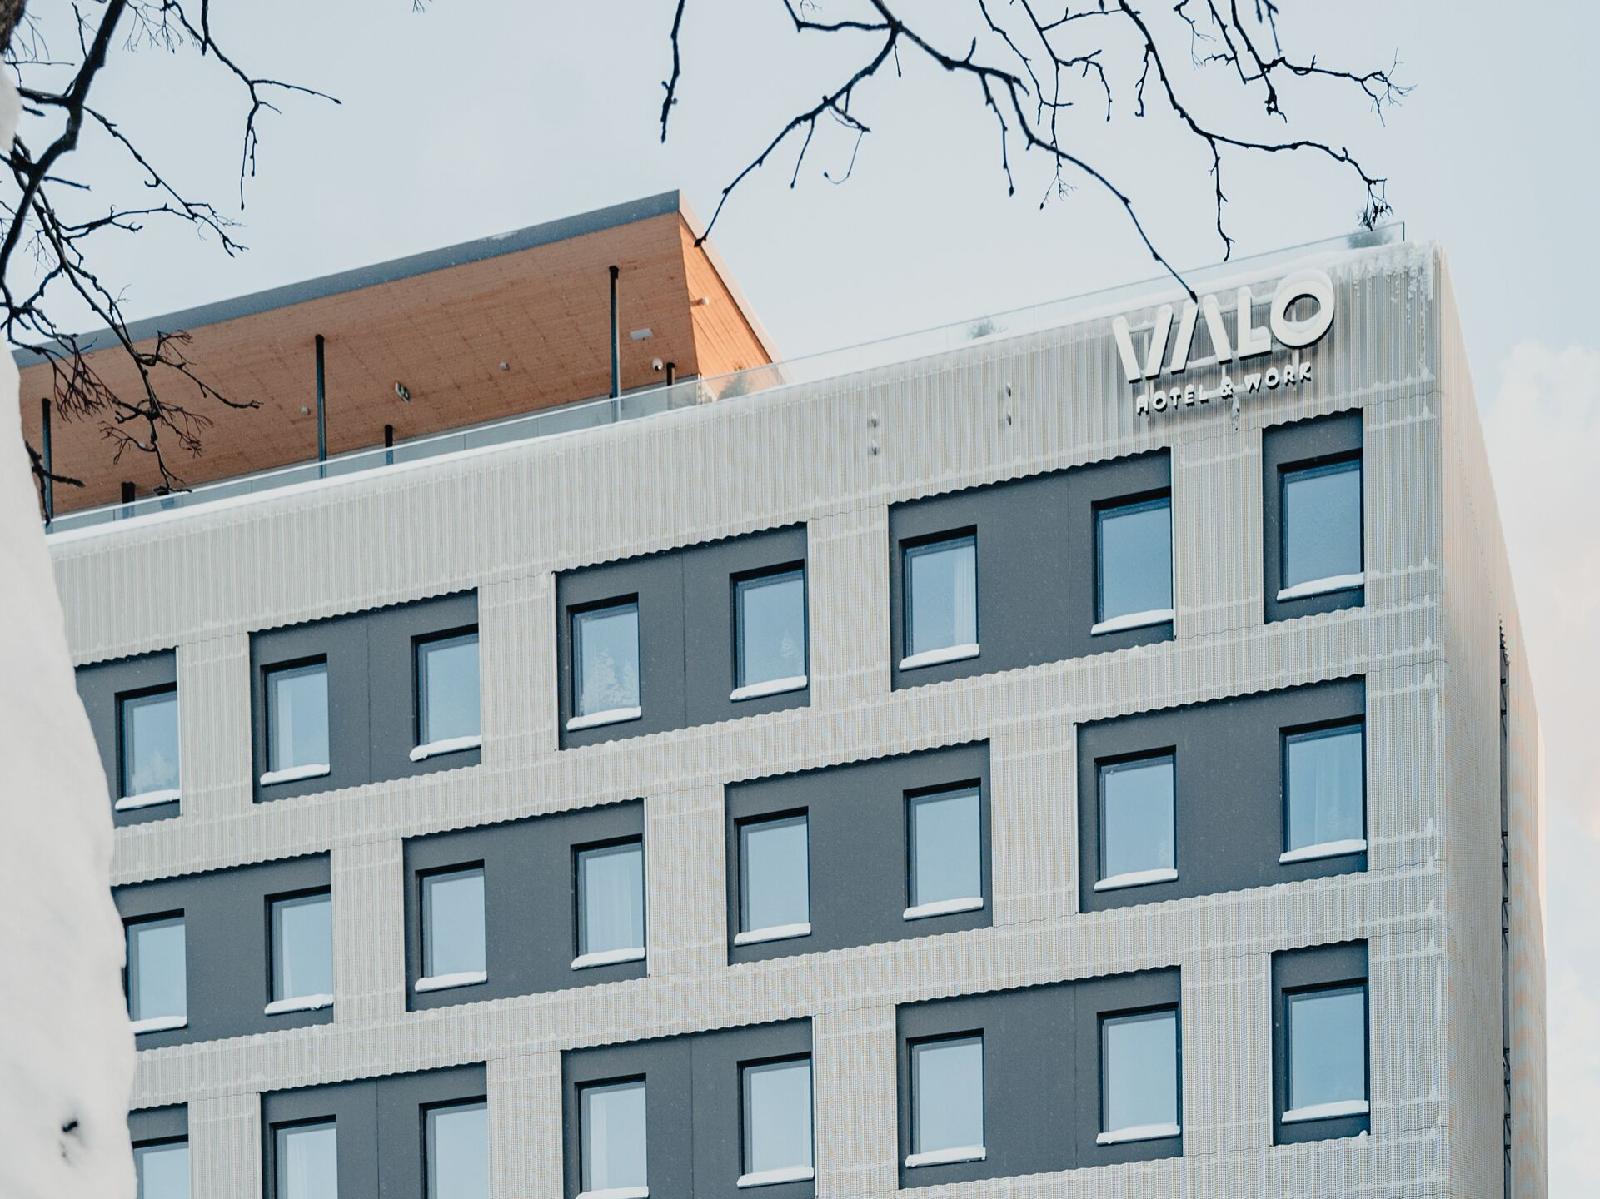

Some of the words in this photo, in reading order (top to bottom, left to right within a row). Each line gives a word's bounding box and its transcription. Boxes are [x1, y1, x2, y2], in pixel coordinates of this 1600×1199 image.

[1112, 269, 1334, 384] VALO
[1136, 385, 1209, 415] HOTEL
[1221, 376, 1234, 399] &
[1244, 361, 1312, 394] WORK
